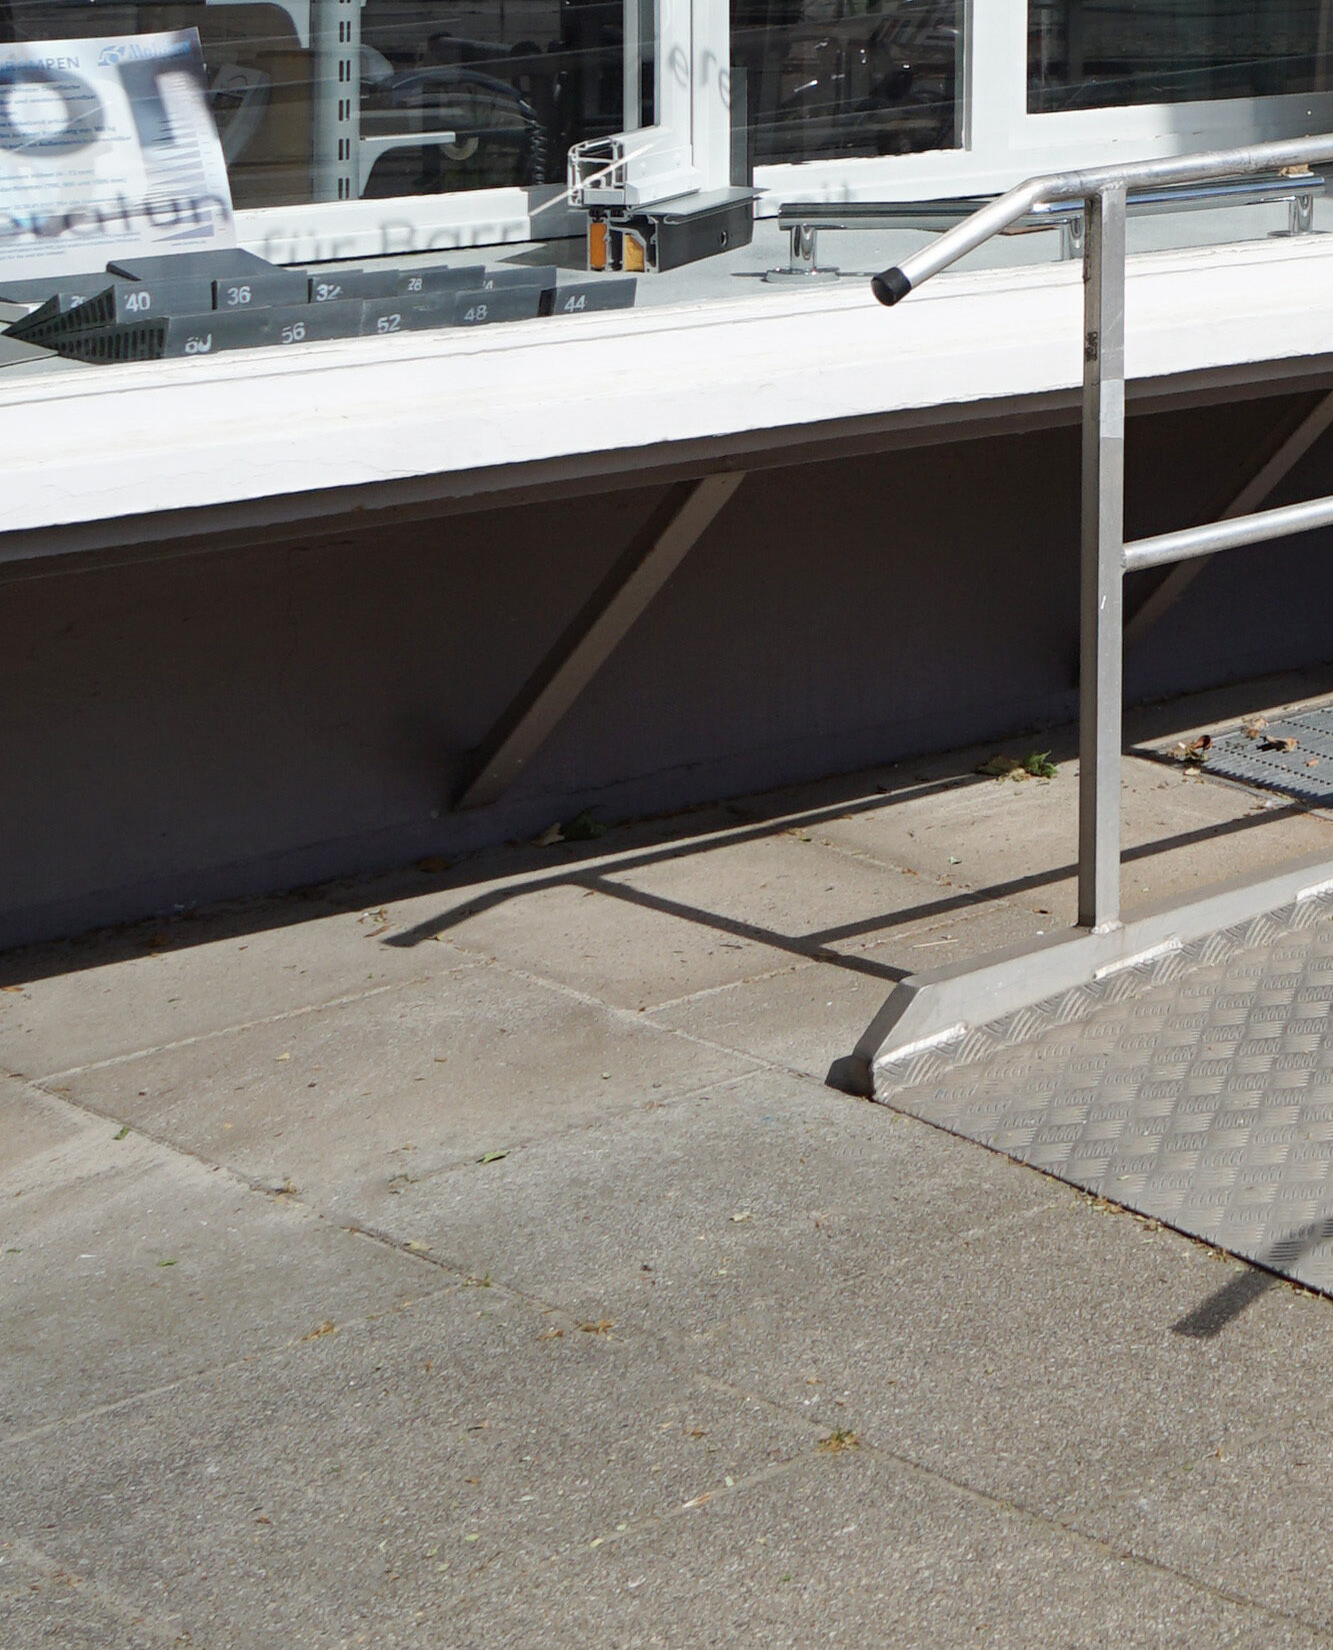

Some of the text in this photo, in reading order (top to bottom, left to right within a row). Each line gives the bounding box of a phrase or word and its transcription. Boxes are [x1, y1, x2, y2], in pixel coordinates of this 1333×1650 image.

[124, 291, 151, 313] 40
[227, 285, 251, 306] 36
[563, 294, 588, 313] 44
[376, 313, 401, 335] 52
[463, 304, 488, 323] 48
[281, 321, 306, 344] 56
